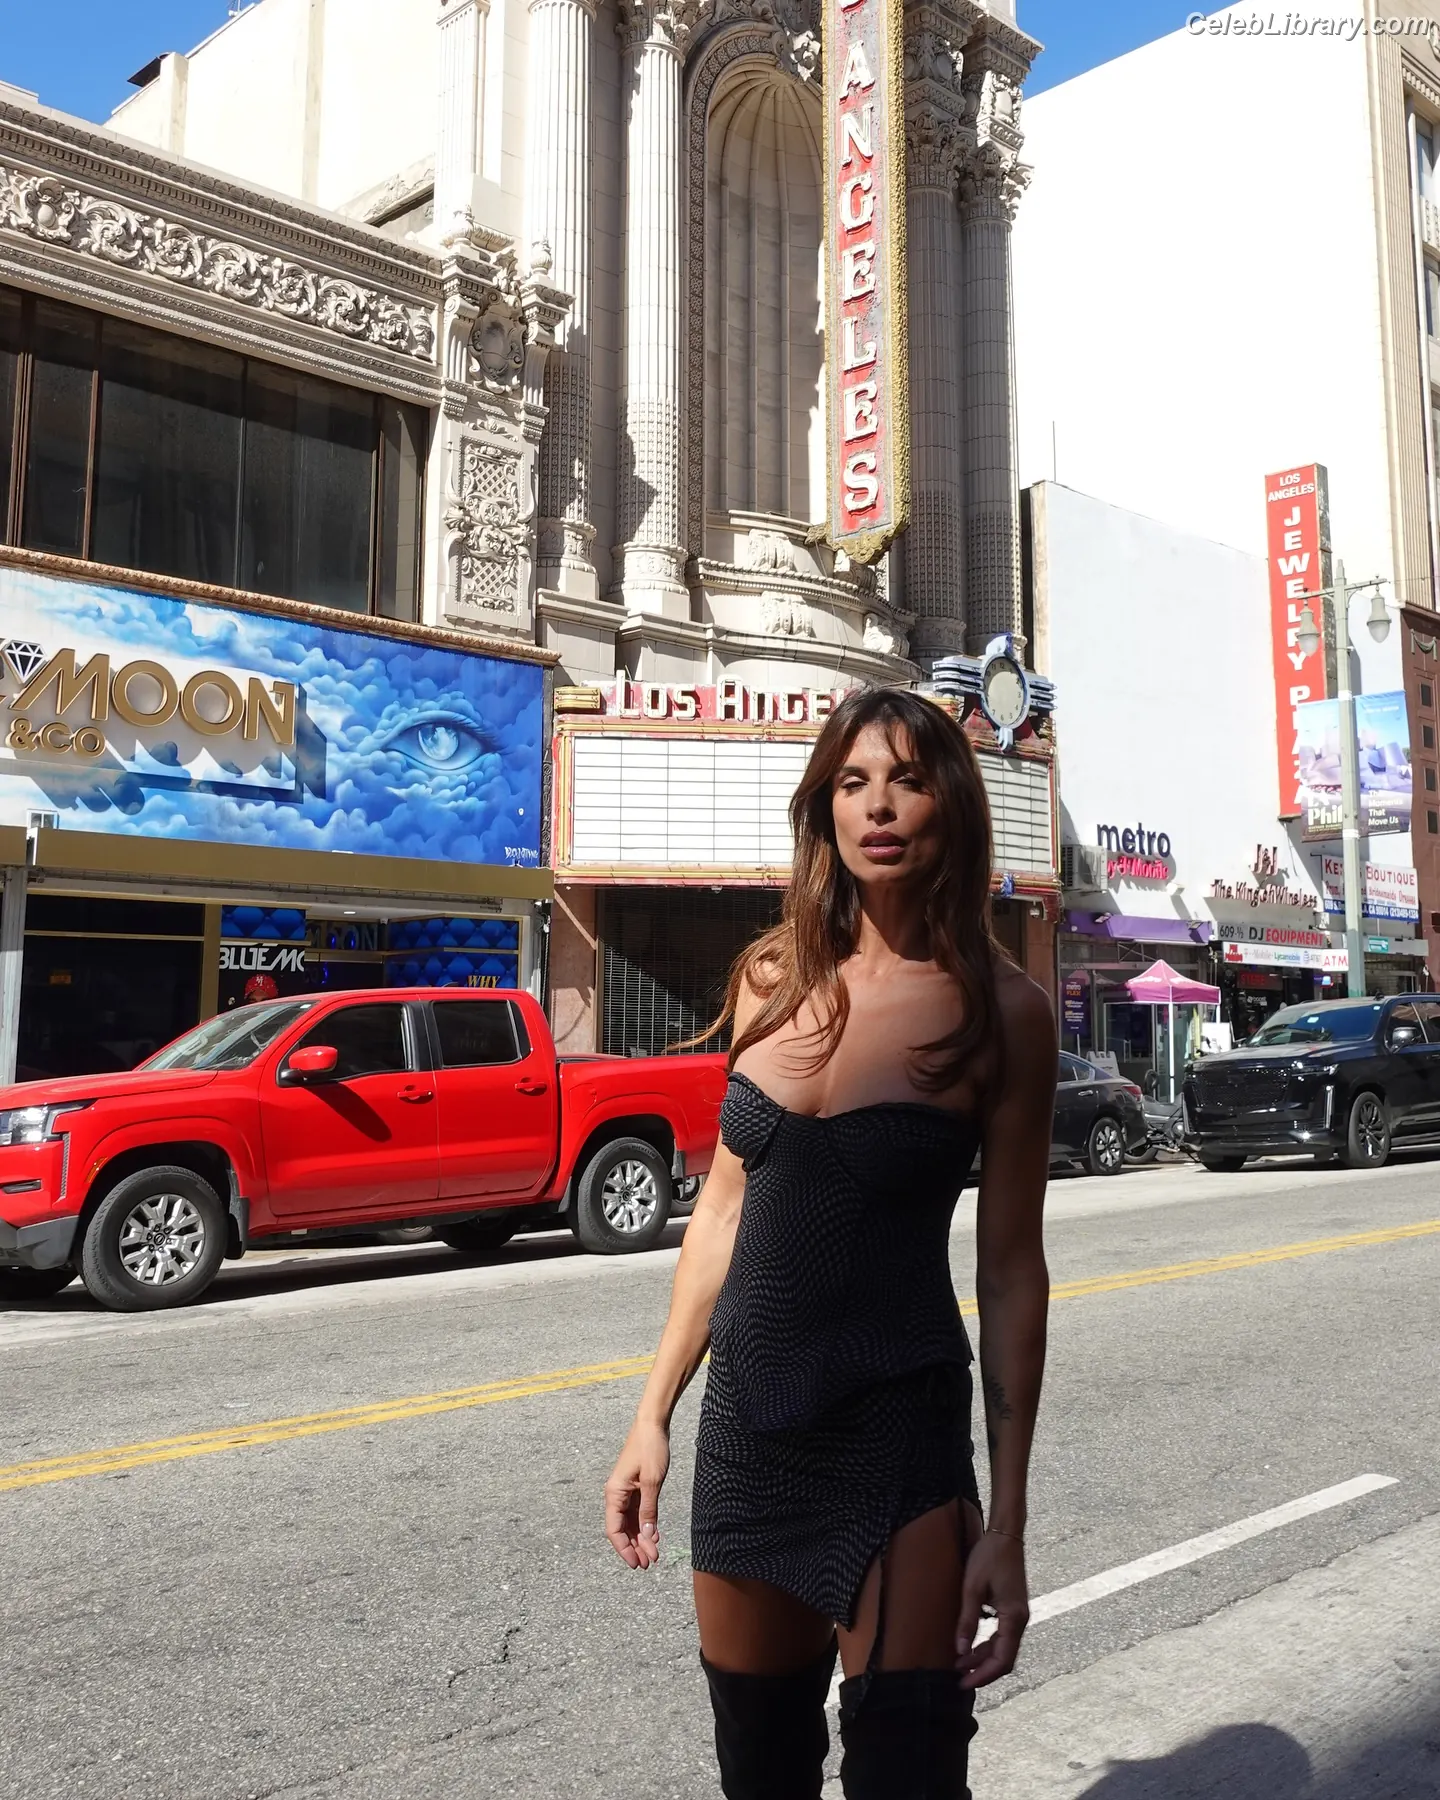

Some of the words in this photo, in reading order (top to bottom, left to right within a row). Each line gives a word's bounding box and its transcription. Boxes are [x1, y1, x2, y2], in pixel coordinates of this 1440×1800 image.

[839, 39, 877, 515] ANGELES
[1279, 473, 1301, 487] LOS
[1267, 482, 1316, 503] ANGELES
[8, 647, 296, 746] MOON
[5, 716, 107, 758] &CO
[1368, 808, 1386, 817] That
[1368, 817, 1388, 826] Move
[1389, 816, 1399, 824] Us
[1096, 822, 1171, 858] metro
[1253, 844, 1278, 877] J&J
[1366, 865, 1415, 886] BOUTIQUE
[1211, 879, 1234, 900] The
[1235, 881, 1260, 908] King
[1248, 926, 1264, 941] DJ
[1265, 927, 1326, 946] EQUIPMENT
[1323, 955, 1348, 968] ATM
[466, 975, 501, 989] WHY
